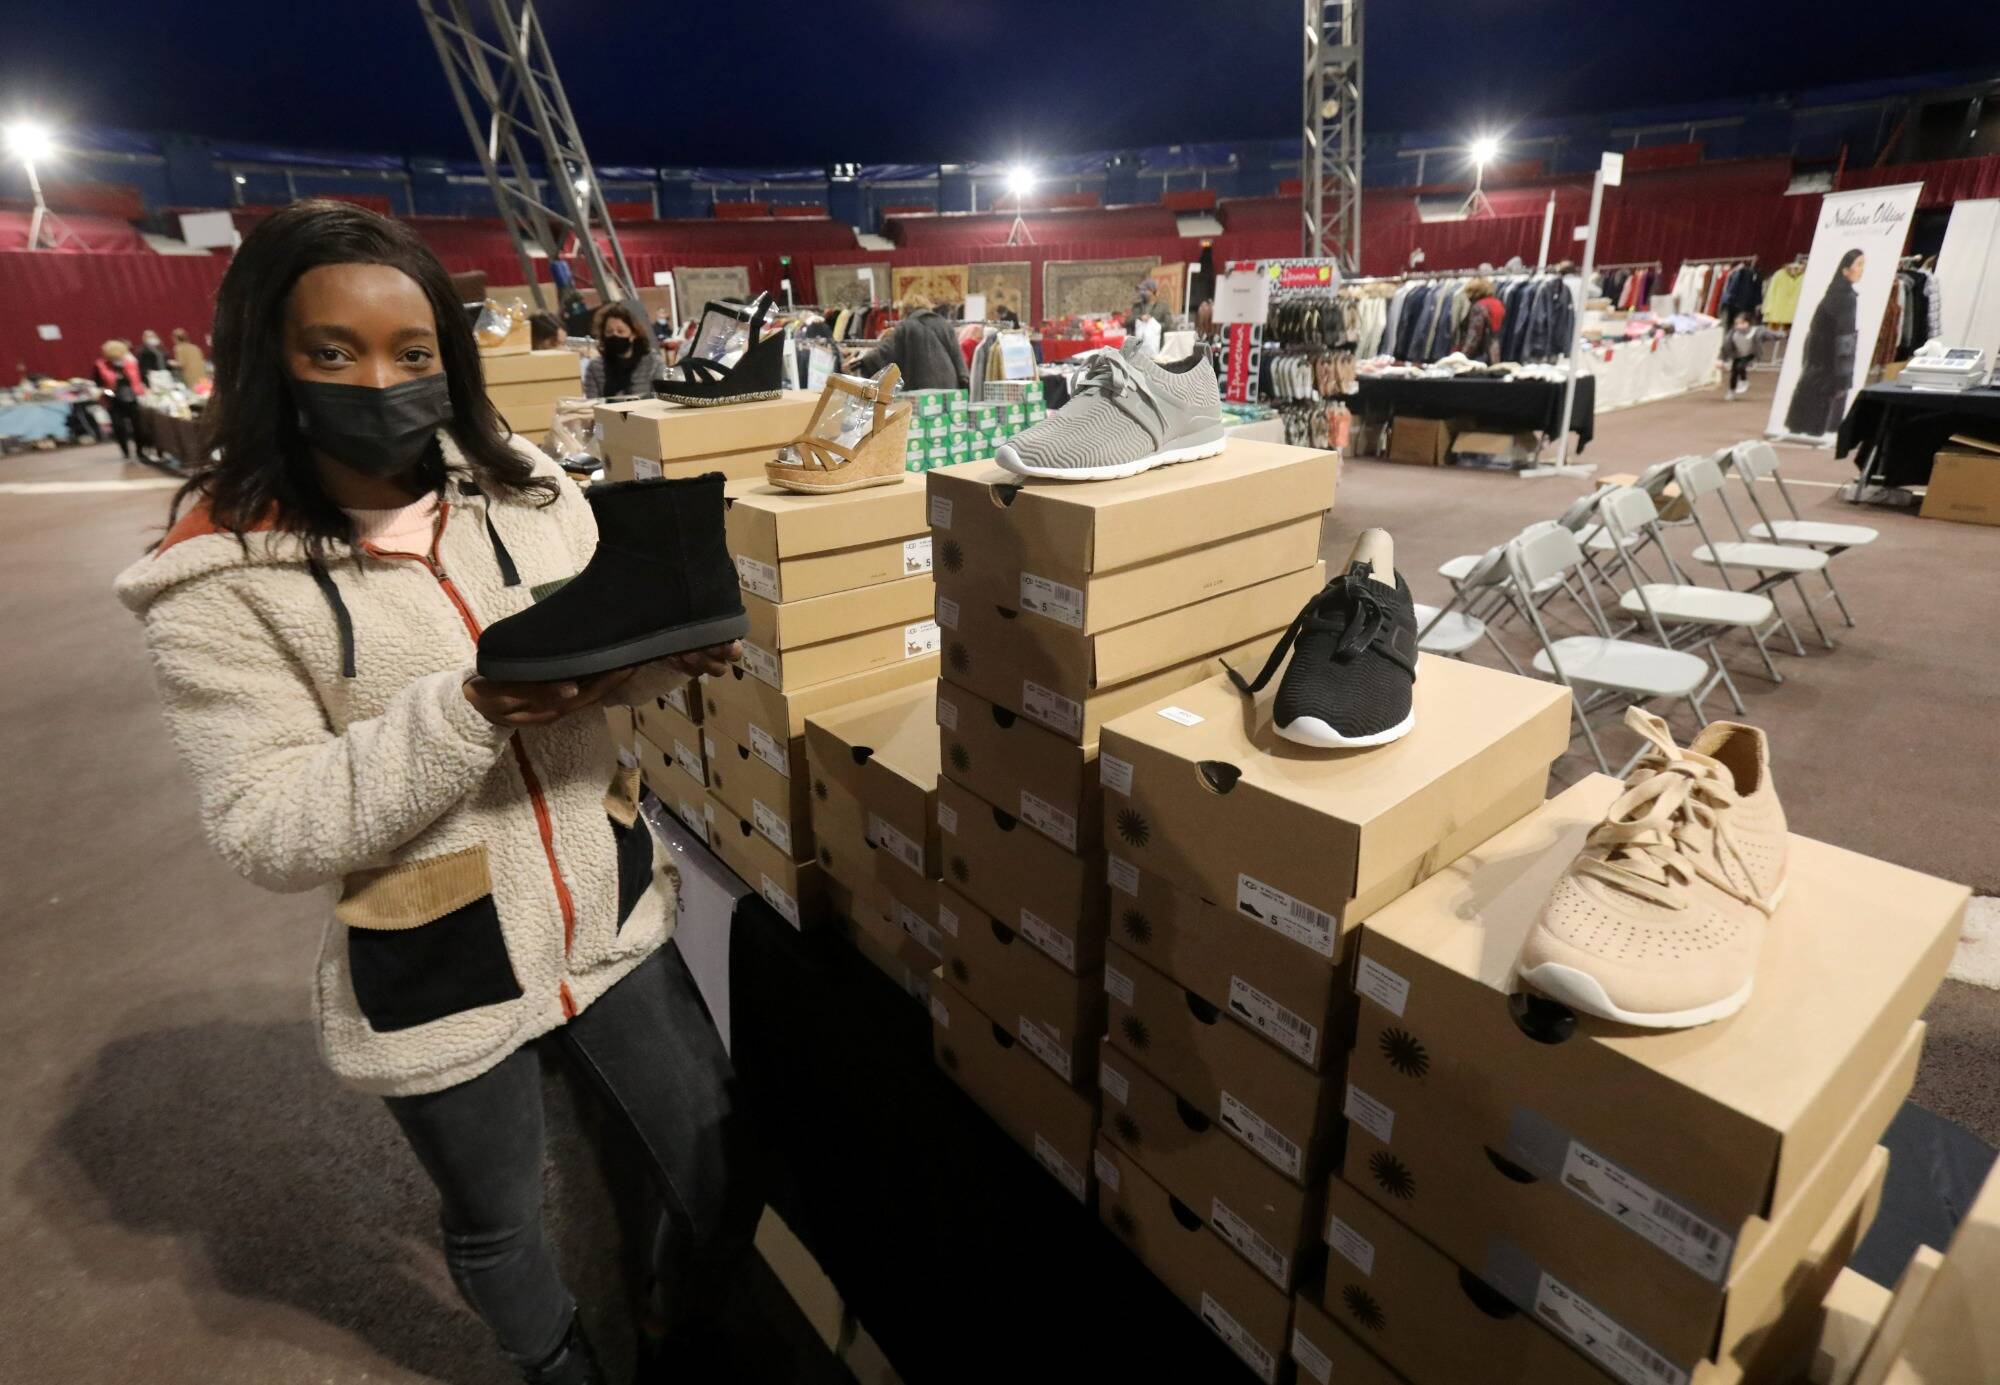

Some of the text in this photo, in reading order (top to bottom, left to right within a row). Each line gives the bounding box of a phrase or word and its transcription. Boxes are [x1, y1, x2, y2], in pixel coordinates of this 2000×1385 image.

[926, 558, 931, 567] 5
[1042, 602, 1048, 612] 5
[926, 641, 932, 649] 6
[1270, 914, 1278, 926] 5
[1258, 1016, 1265, 1027] 6
[1616, 1202, 1630, 1216] 7
[1584, 1333, 1597, 1346] 7
